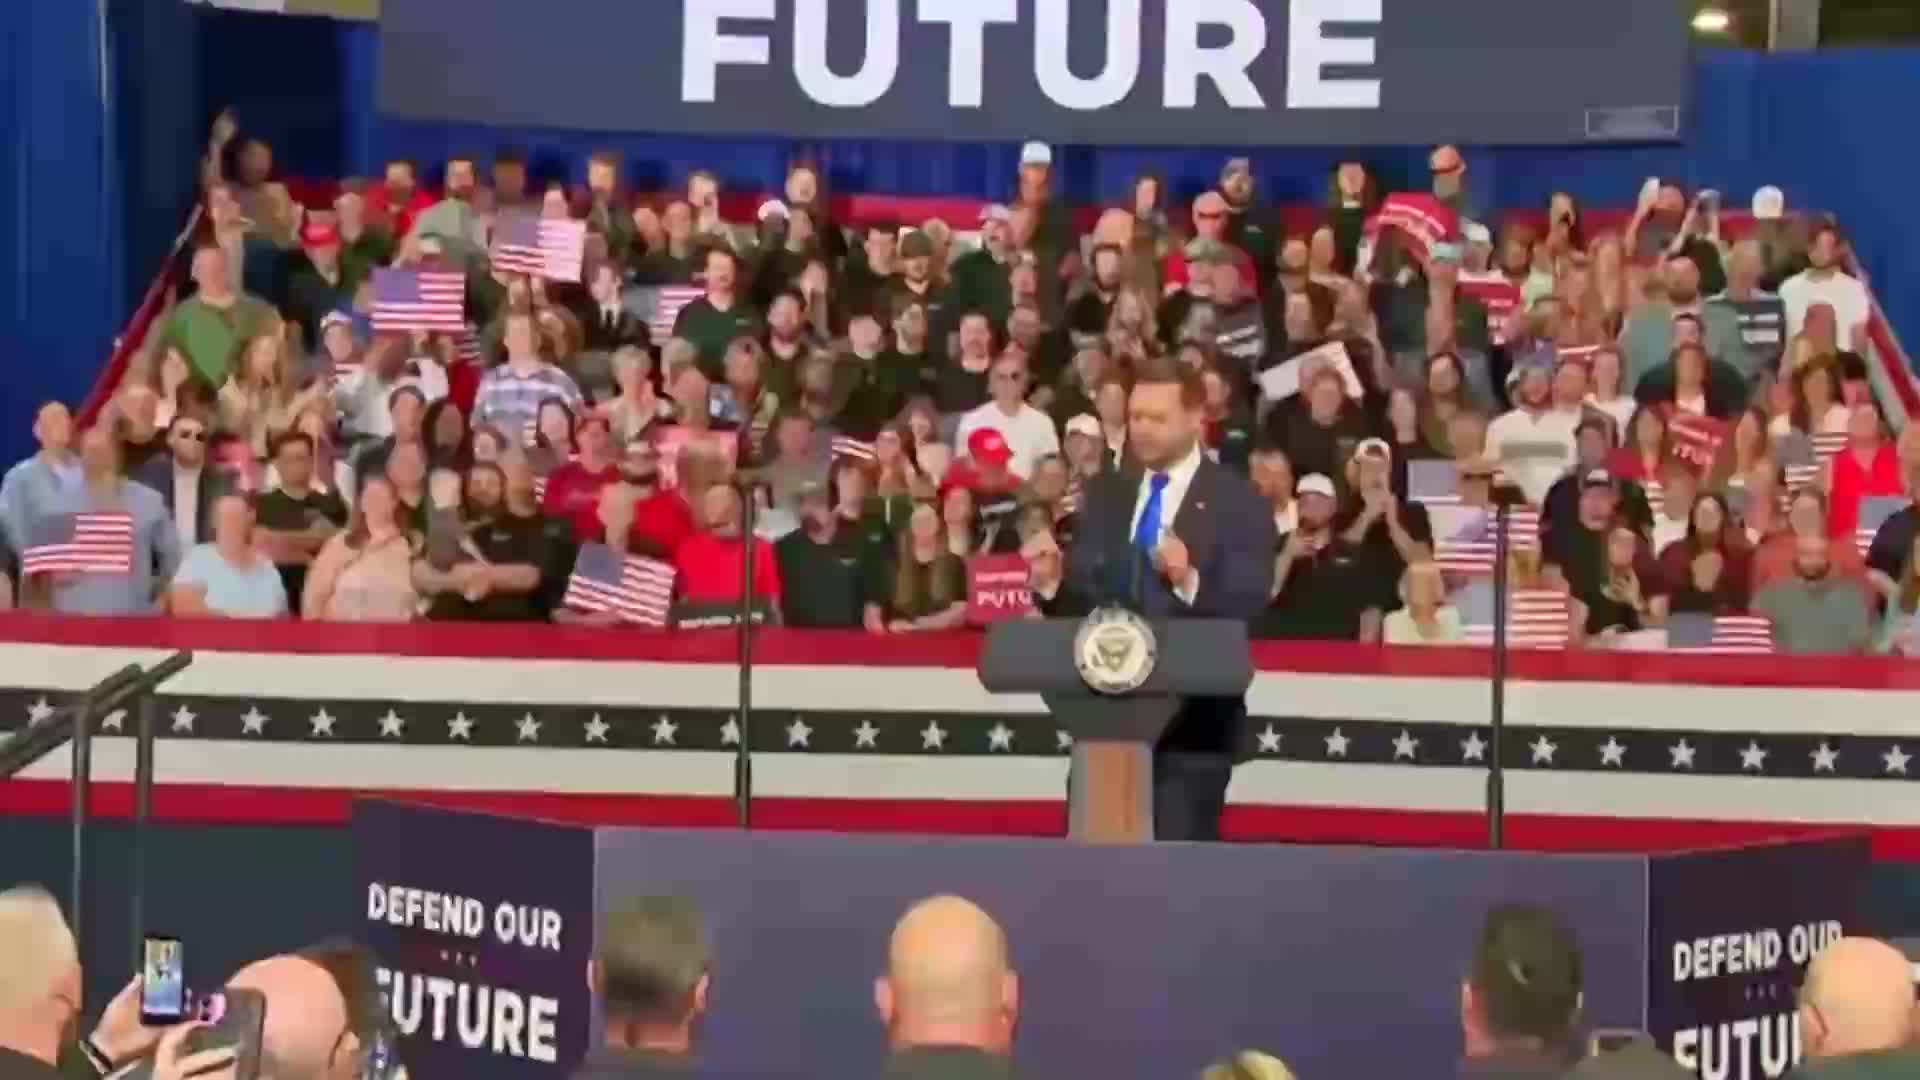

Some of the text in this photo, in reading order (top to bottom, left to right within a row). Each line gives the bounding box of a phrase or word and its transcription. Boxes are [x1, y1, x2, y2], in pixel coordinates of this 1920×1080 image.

[681, 0, 1382, 110] FUTURE
[367, 881, 563, 951] DEFEND OUR
[1673, 928, 1782, 982] DEFEND
